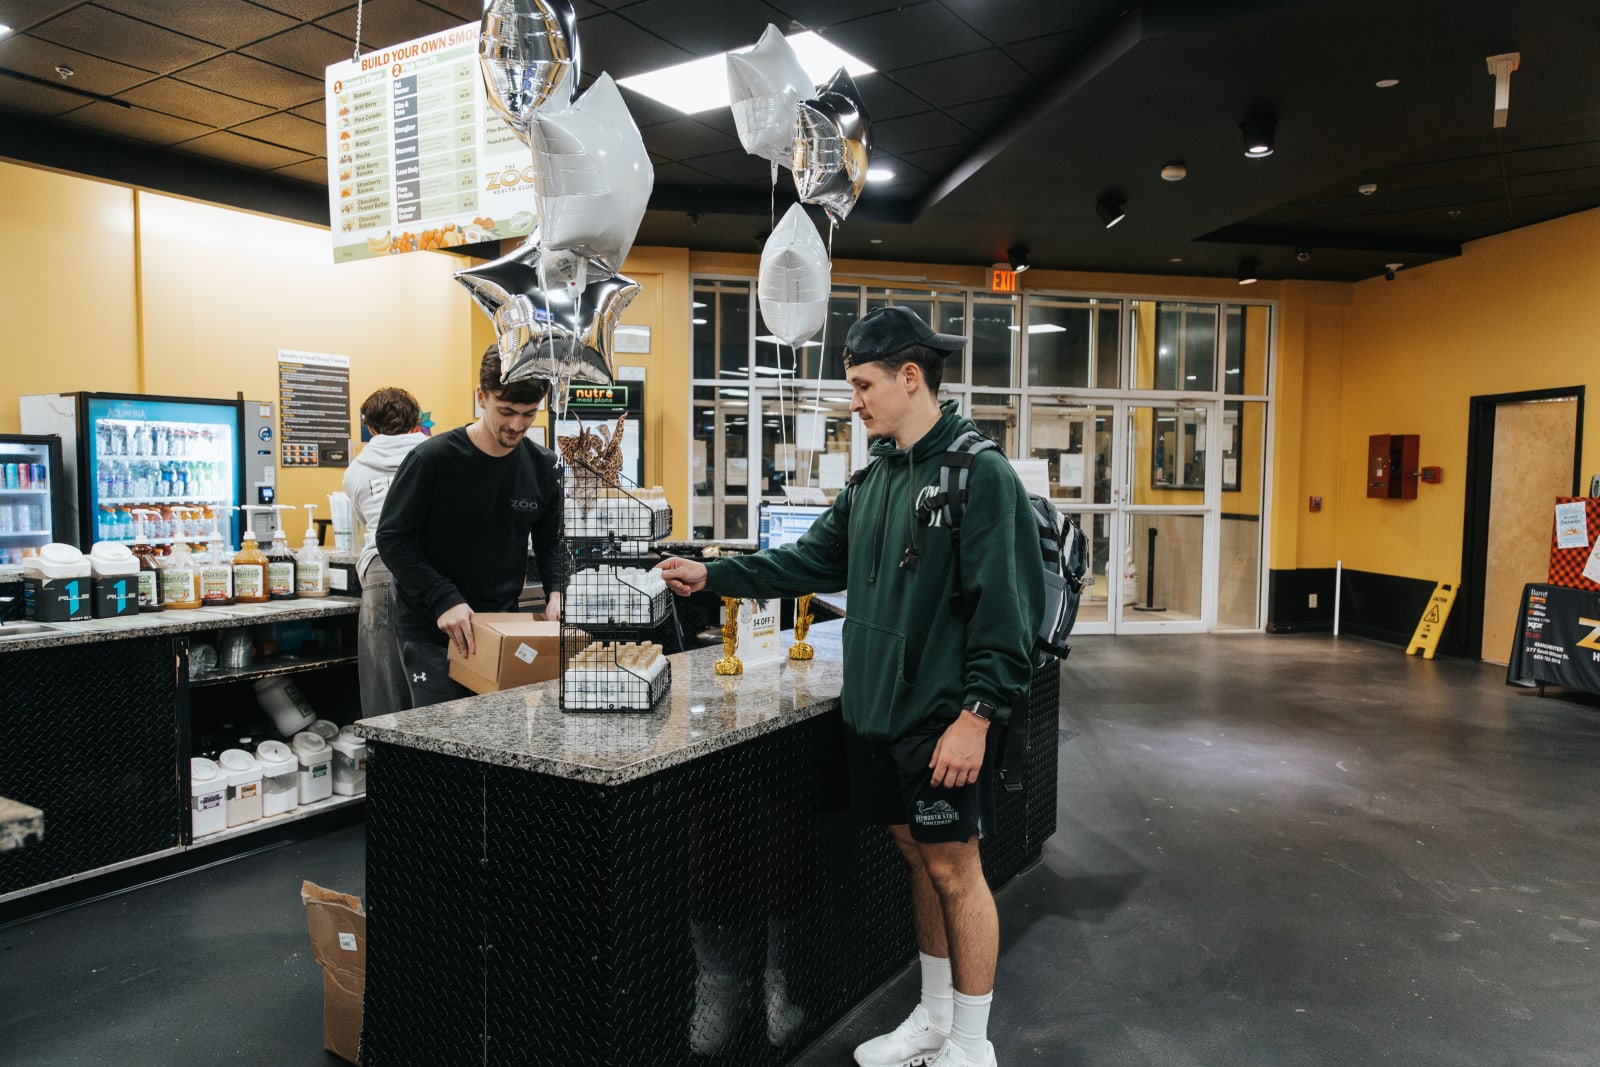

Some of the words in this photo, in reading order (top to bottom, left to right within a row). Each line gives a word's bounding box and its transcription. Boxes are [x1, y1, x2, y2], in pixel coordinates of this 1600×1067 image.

[361, 53, 390, 71] BUILD
[391, 44, 419, 62] YOUR
[420, 37, 446, 54] OWN
[365, 101, 377, 109] Berry
[354, 125, 379, 135] Strawberry
[493, 187, 516, 195] HEALTH
[992, 270, 1017, 292] EXIT
[510, 499, 538, 509] ZOO
[761, 616, 771, 625] OFF
[942, 811, 960, 820] STATE
